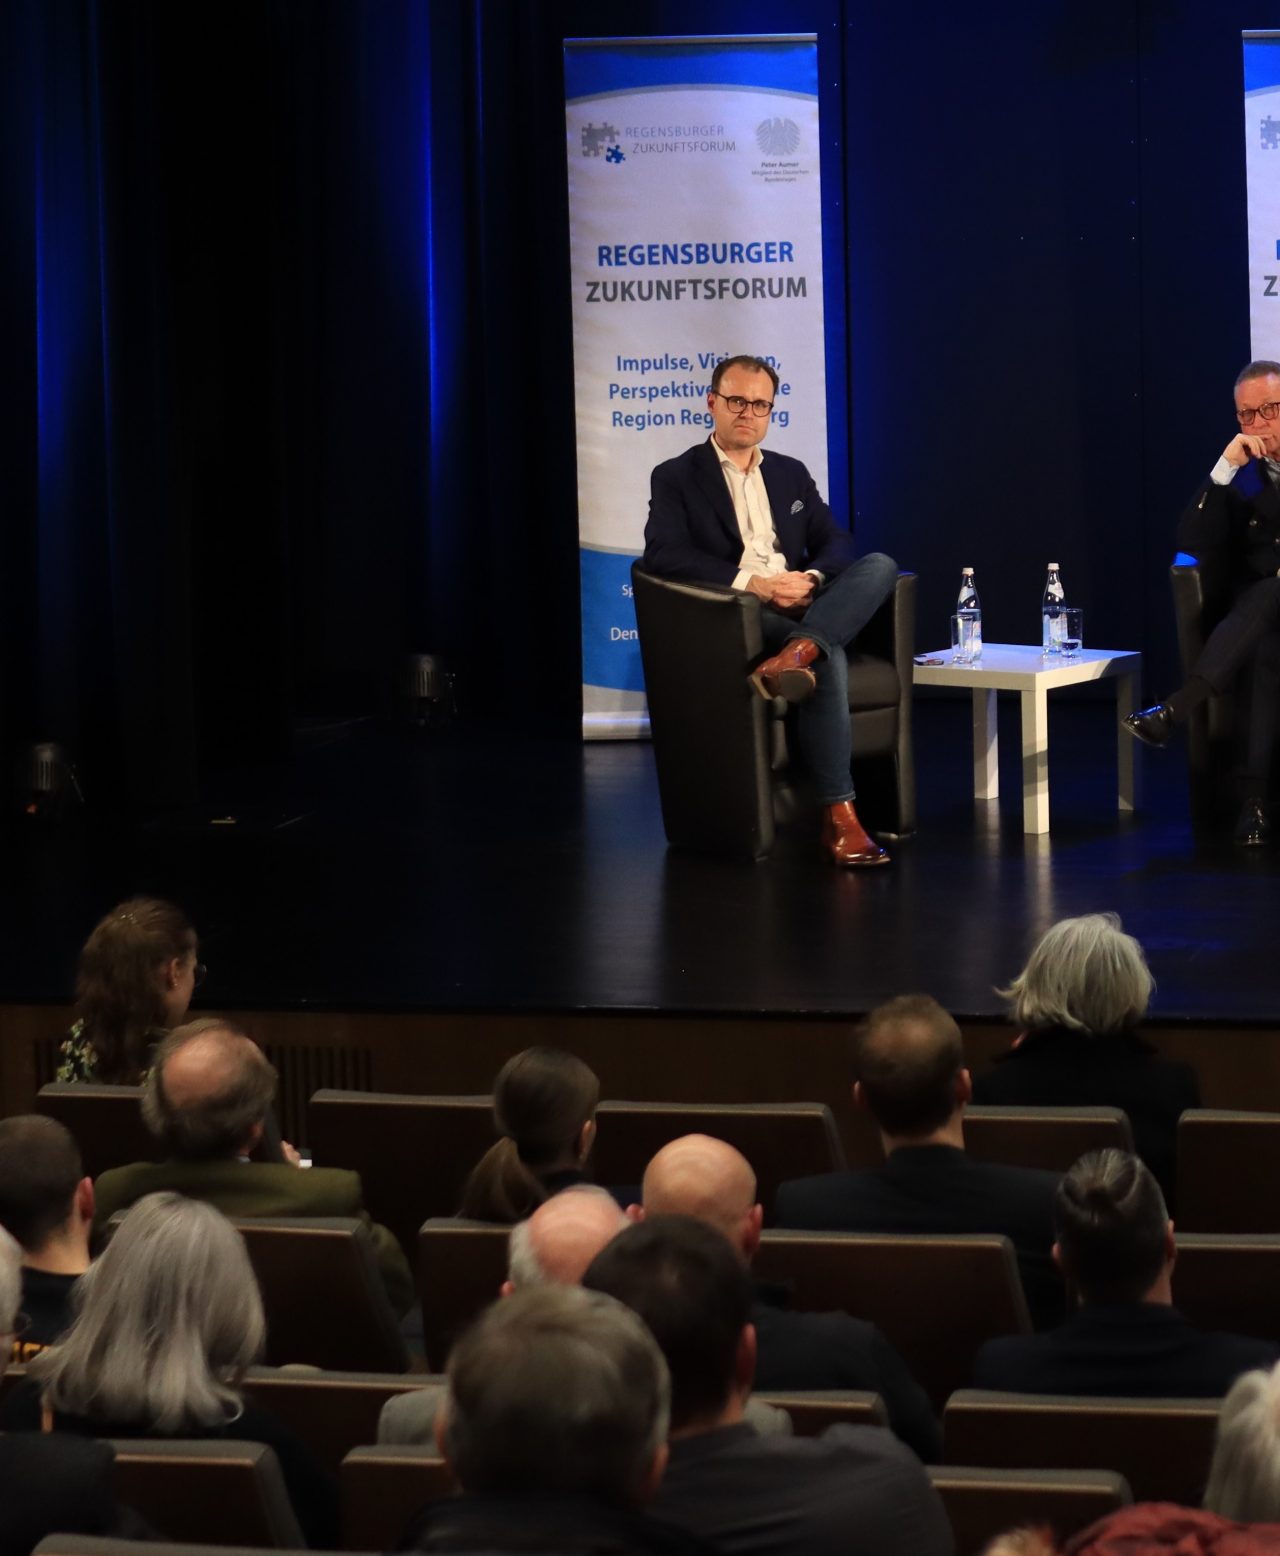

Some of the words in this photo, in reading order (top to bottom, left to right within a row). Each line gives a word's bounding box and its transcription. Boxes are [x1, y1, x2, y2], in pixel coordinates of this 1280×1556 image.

[625, 125, 725, 138] REGENSBURGER
[633, 141, 736, 154] ZUKUNFTSFORUM
[597, 241, 794, 267] REGENSBURGER
[585, 276, 807, 303] ZUKUNFTSFORUM
[616, 353, 694, 374] Impulse,
[612, 410, 675, 430] Region
